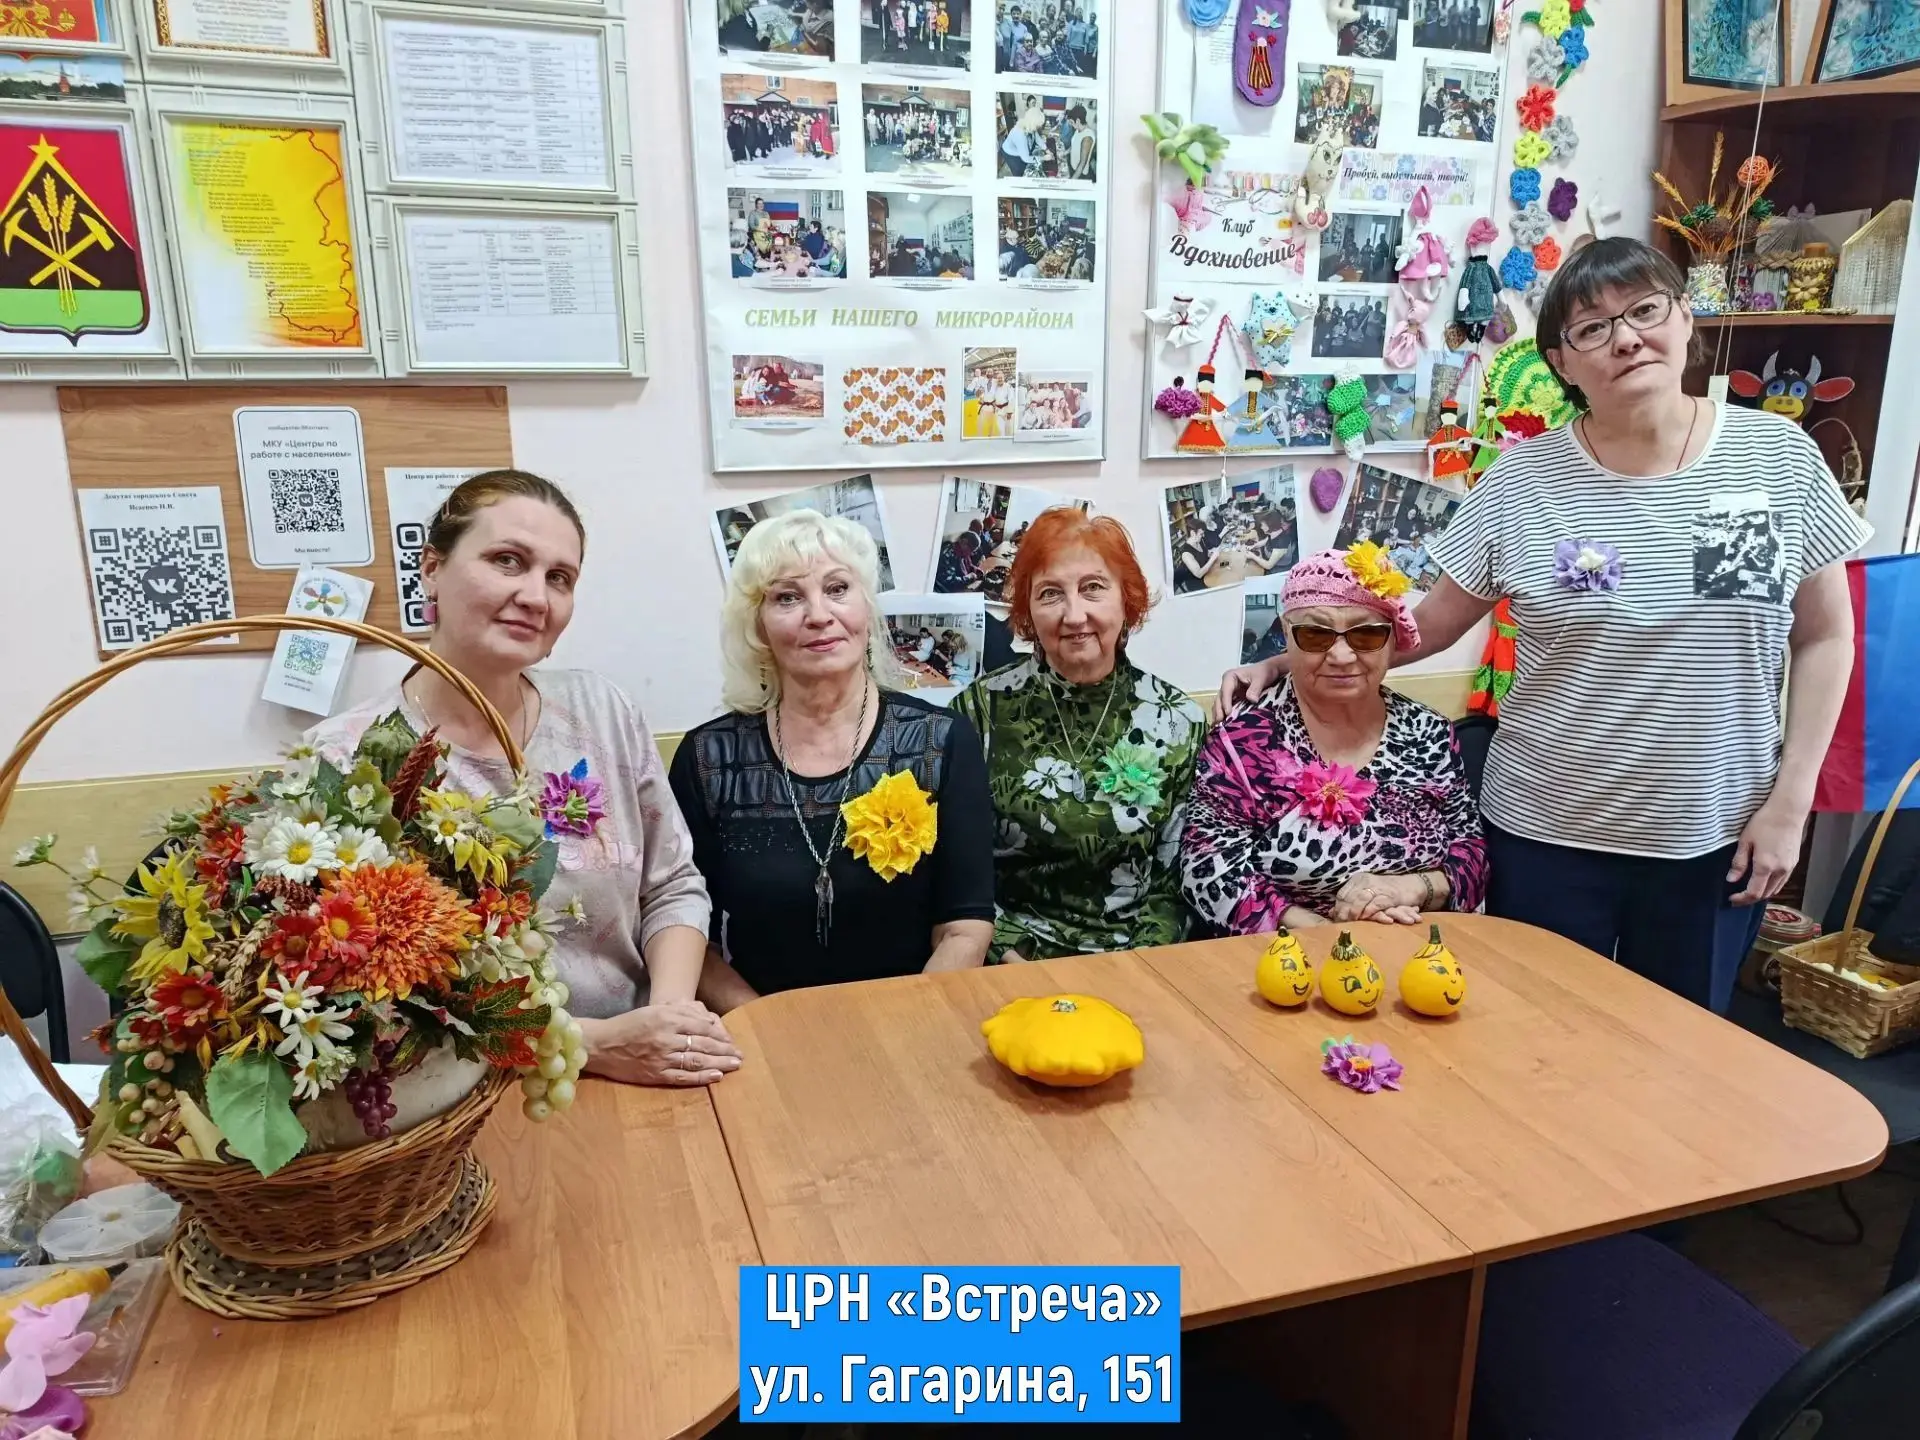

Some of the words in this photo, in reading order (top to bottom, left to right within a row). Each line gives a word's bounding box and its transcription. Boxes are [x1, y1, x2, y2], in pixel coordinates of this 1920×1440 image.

[1343, 167, 1379, 181] Пробуй,
[1381, 170, 1435, 182] выдумывай,
[1437, 172, 1469, 184] твори!
[1222, 218, 1255, 238] Клуб
[1169, 234, 1296, 269] Вдохновение
[744, 308, 818, 328] СЕМЬИ
[831, 308, 919, 328] НАШЕГО
[935, 306, 1075, 330] МИКРОРАЙОНА
[262, 440, 282, 449] МКУ
[285, 439, 325, 449] «Центры
[326, 440, 338, 448] по
[250, 450, 283, 460] работе
[292, 451, 352, 459] населением»
[405, 473, 425, 481] Центр
